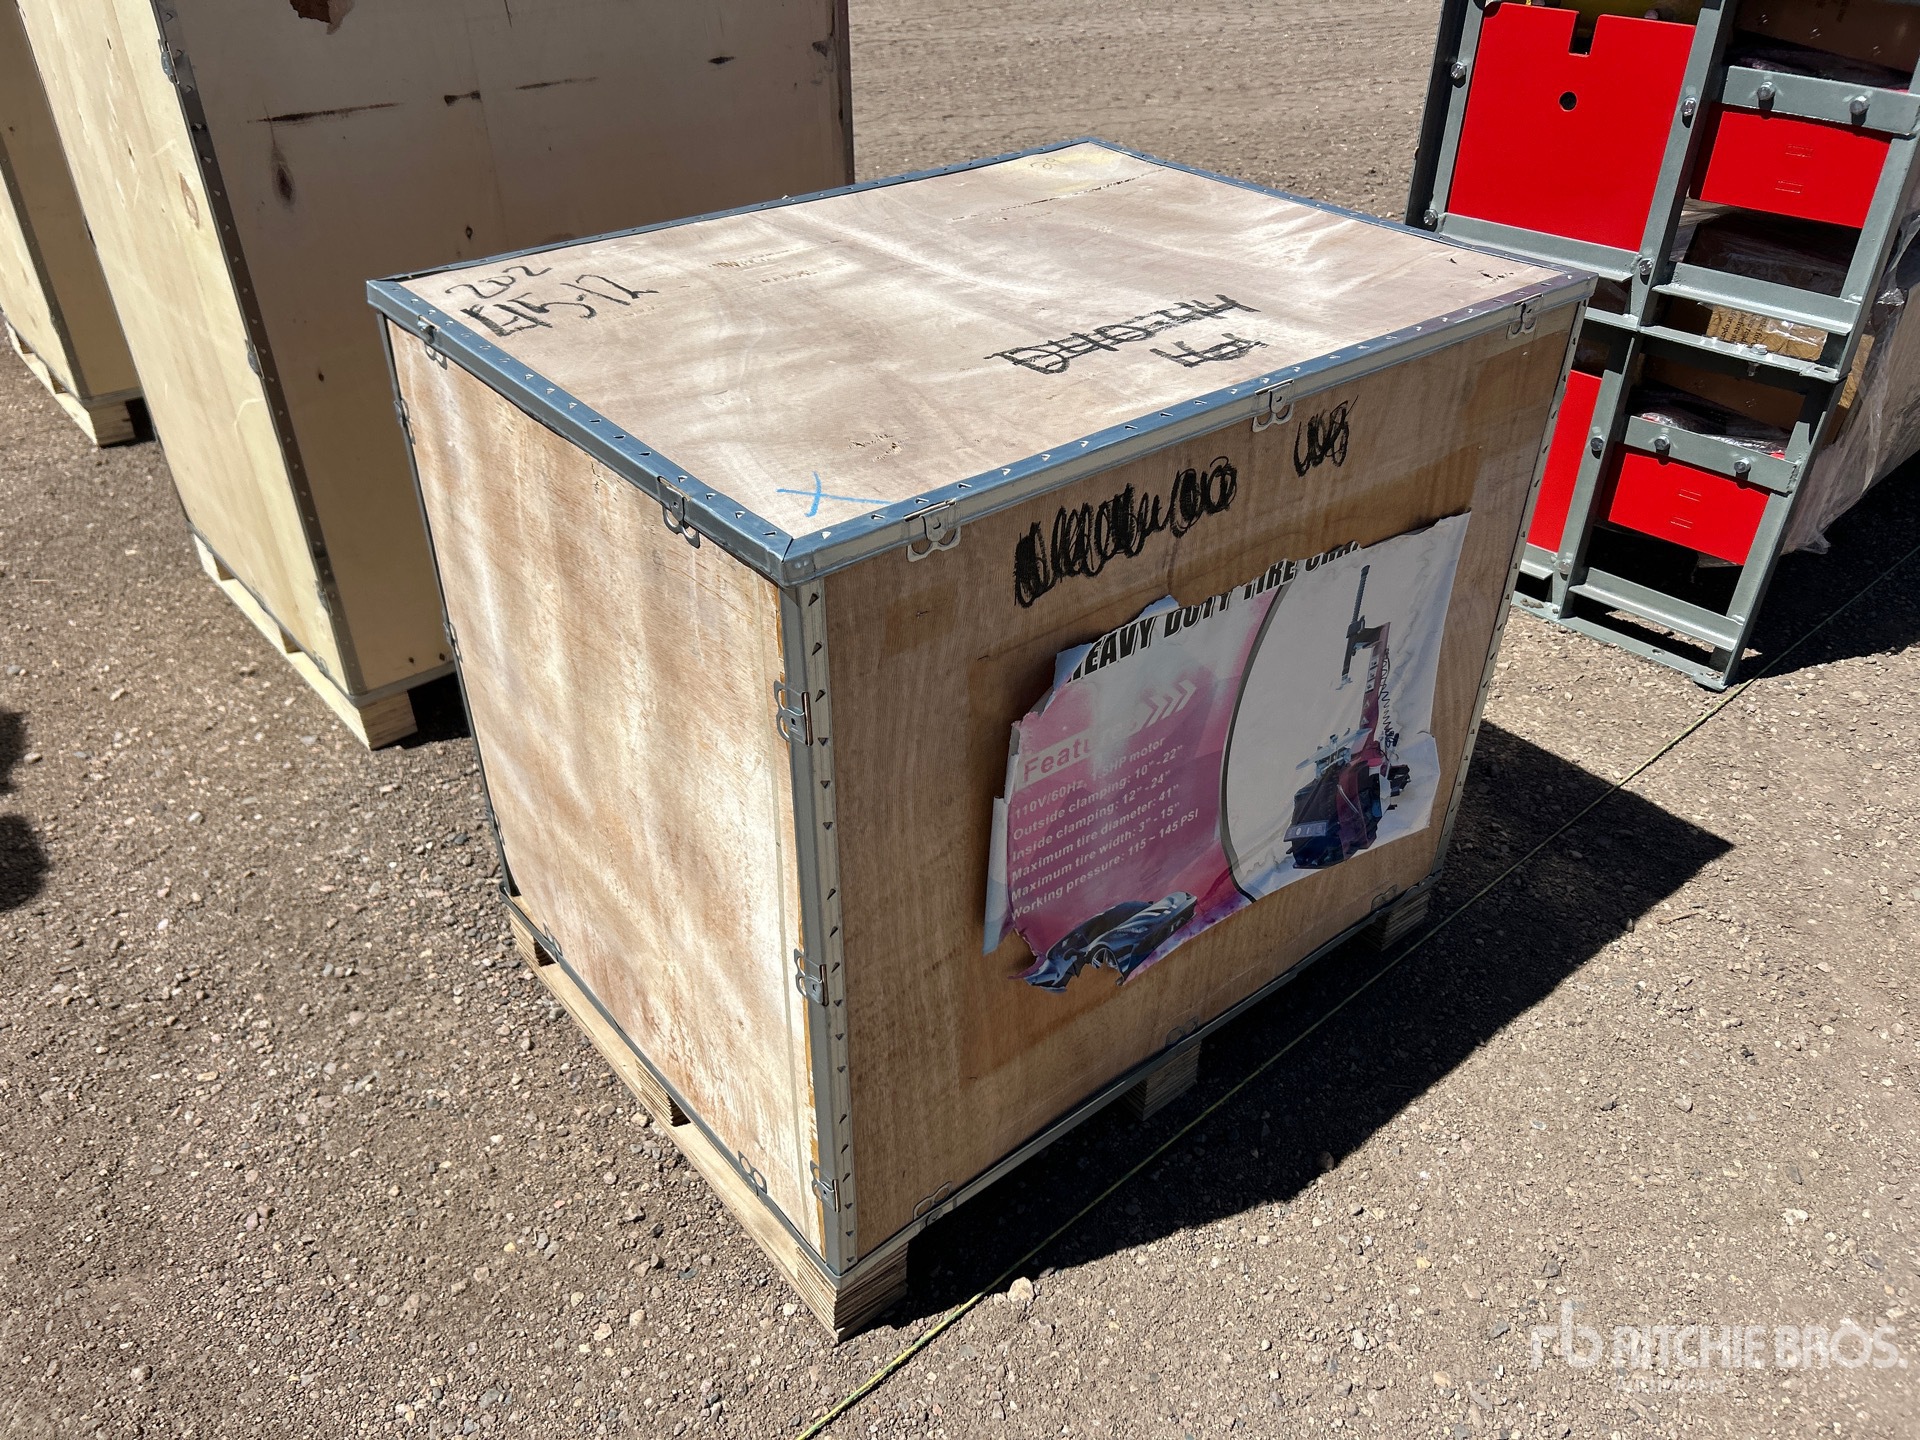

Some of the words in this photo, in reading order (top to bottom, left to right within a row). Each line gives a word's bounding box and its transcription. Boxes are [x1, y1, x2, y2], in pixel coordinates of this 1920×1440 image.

[445, 265, 552, 299] 202
[1129, 738, 1166, 762] motor
[1012, 835, 1053, 862] Inside
[1056, 800, 1119, 839] clamping:
[1012, 843, 1074, 882] Maximum
[1076, 831, 1098, 848] tire
[1100, 798, 1156, 835] diameter:
[1013, 809, 1065, 840] Outside
[1068, 775, 1132, 813] clamping:
[1011, 887, 1063, 921] Working
[1066, 853, 1125, 893] pressure:
[1128, 838, 1146, 856] 115
[1159, 820, 1179, 838] 145
[1180, 808, 1199, 827] PSI
[1011, 863, 1072, 903] Maximum
[1075, 851, 1096, 867] tire
[1099, 828, 1136, 854] width:
